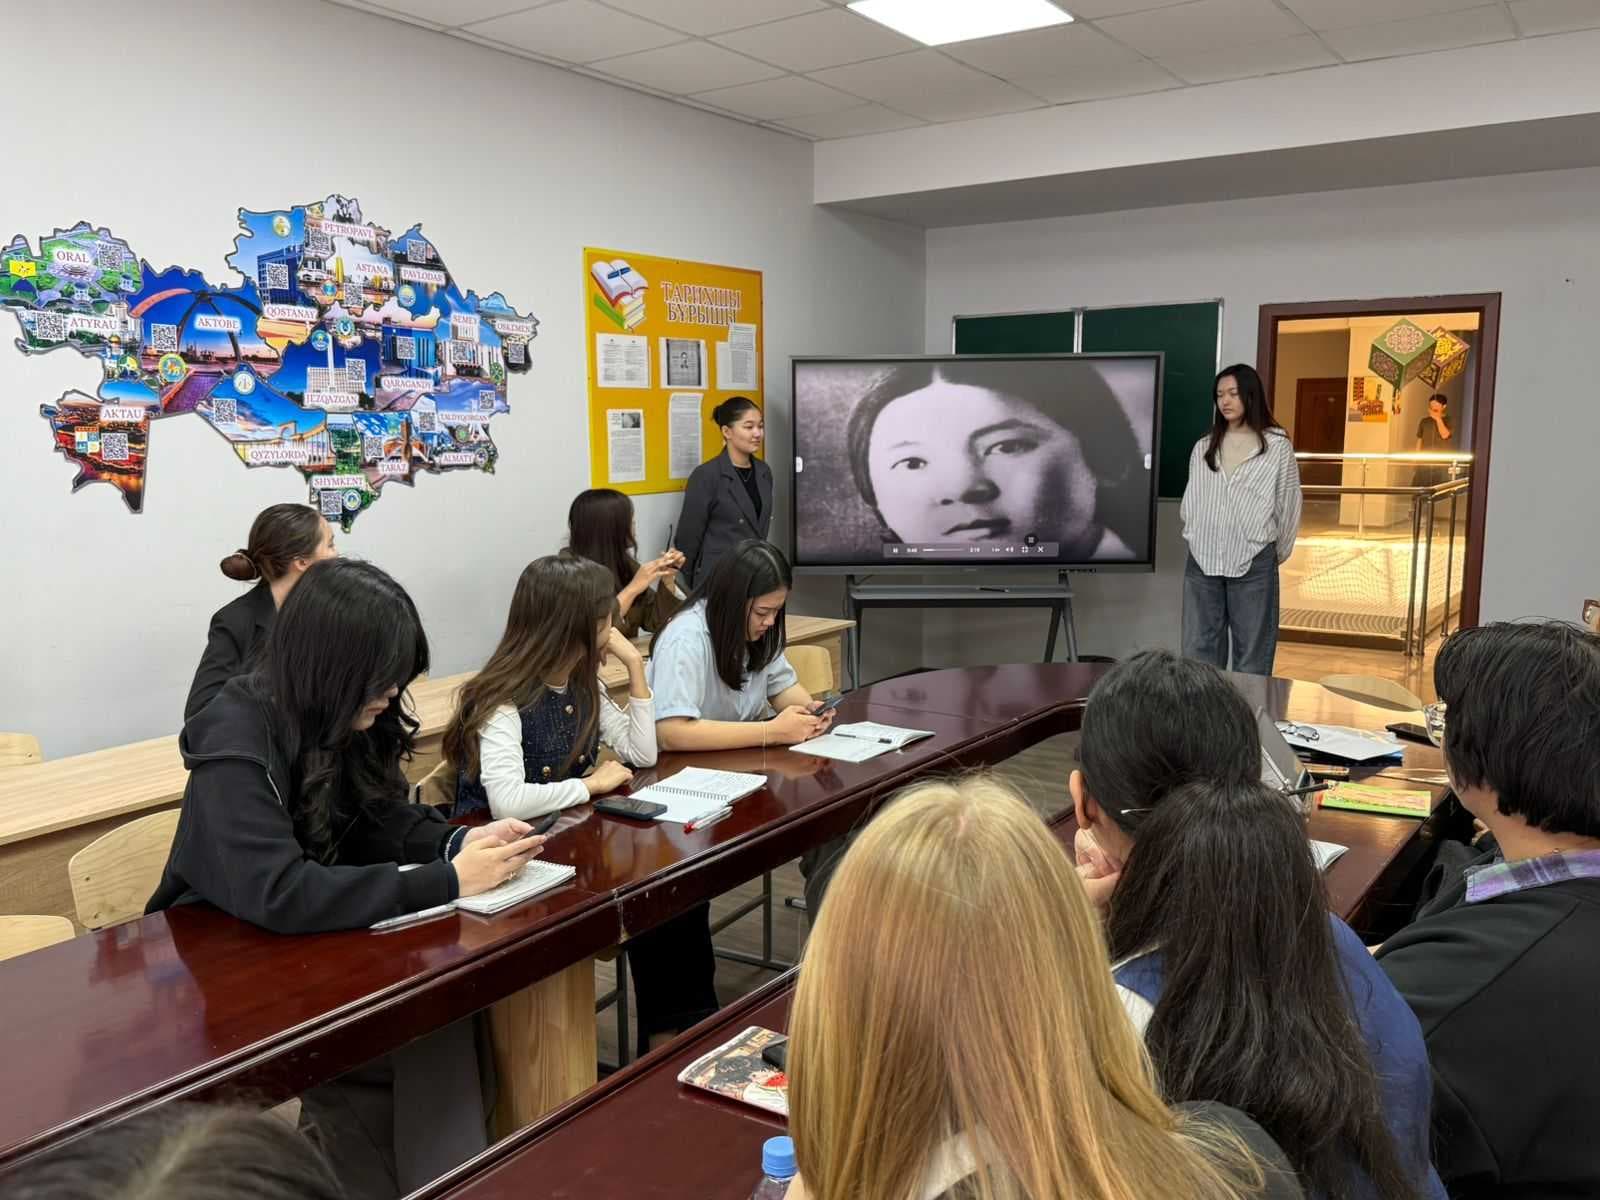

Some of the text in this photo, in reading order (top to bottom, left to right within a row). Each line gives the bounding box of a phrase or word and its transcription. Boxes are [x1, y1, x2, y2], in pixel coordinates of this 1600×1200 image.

[324, 222, 375, 238] PETROPAVL
[56, 251, 89, 263] ORAL
[355, 263, 390, 275] ASTANA
[402, 270, 443, 282] PAVLODAR
[661, 281, 741, 309] ТАРИХШЫ
[266, 305, 317, 319] QOSTANAY
[69, 318, 119, 329] ATYRAU
[198, 317, 240, 329] AKTOBE
[103, 408, 142, 419] AKTAU
[250, 450, 307, 460] QYZYLORDA
[442, 455, 474, 464] ALMATY
[380, 463, 407, 473] TARAZ
[314, 477, 364, 488] SHYMKENT
